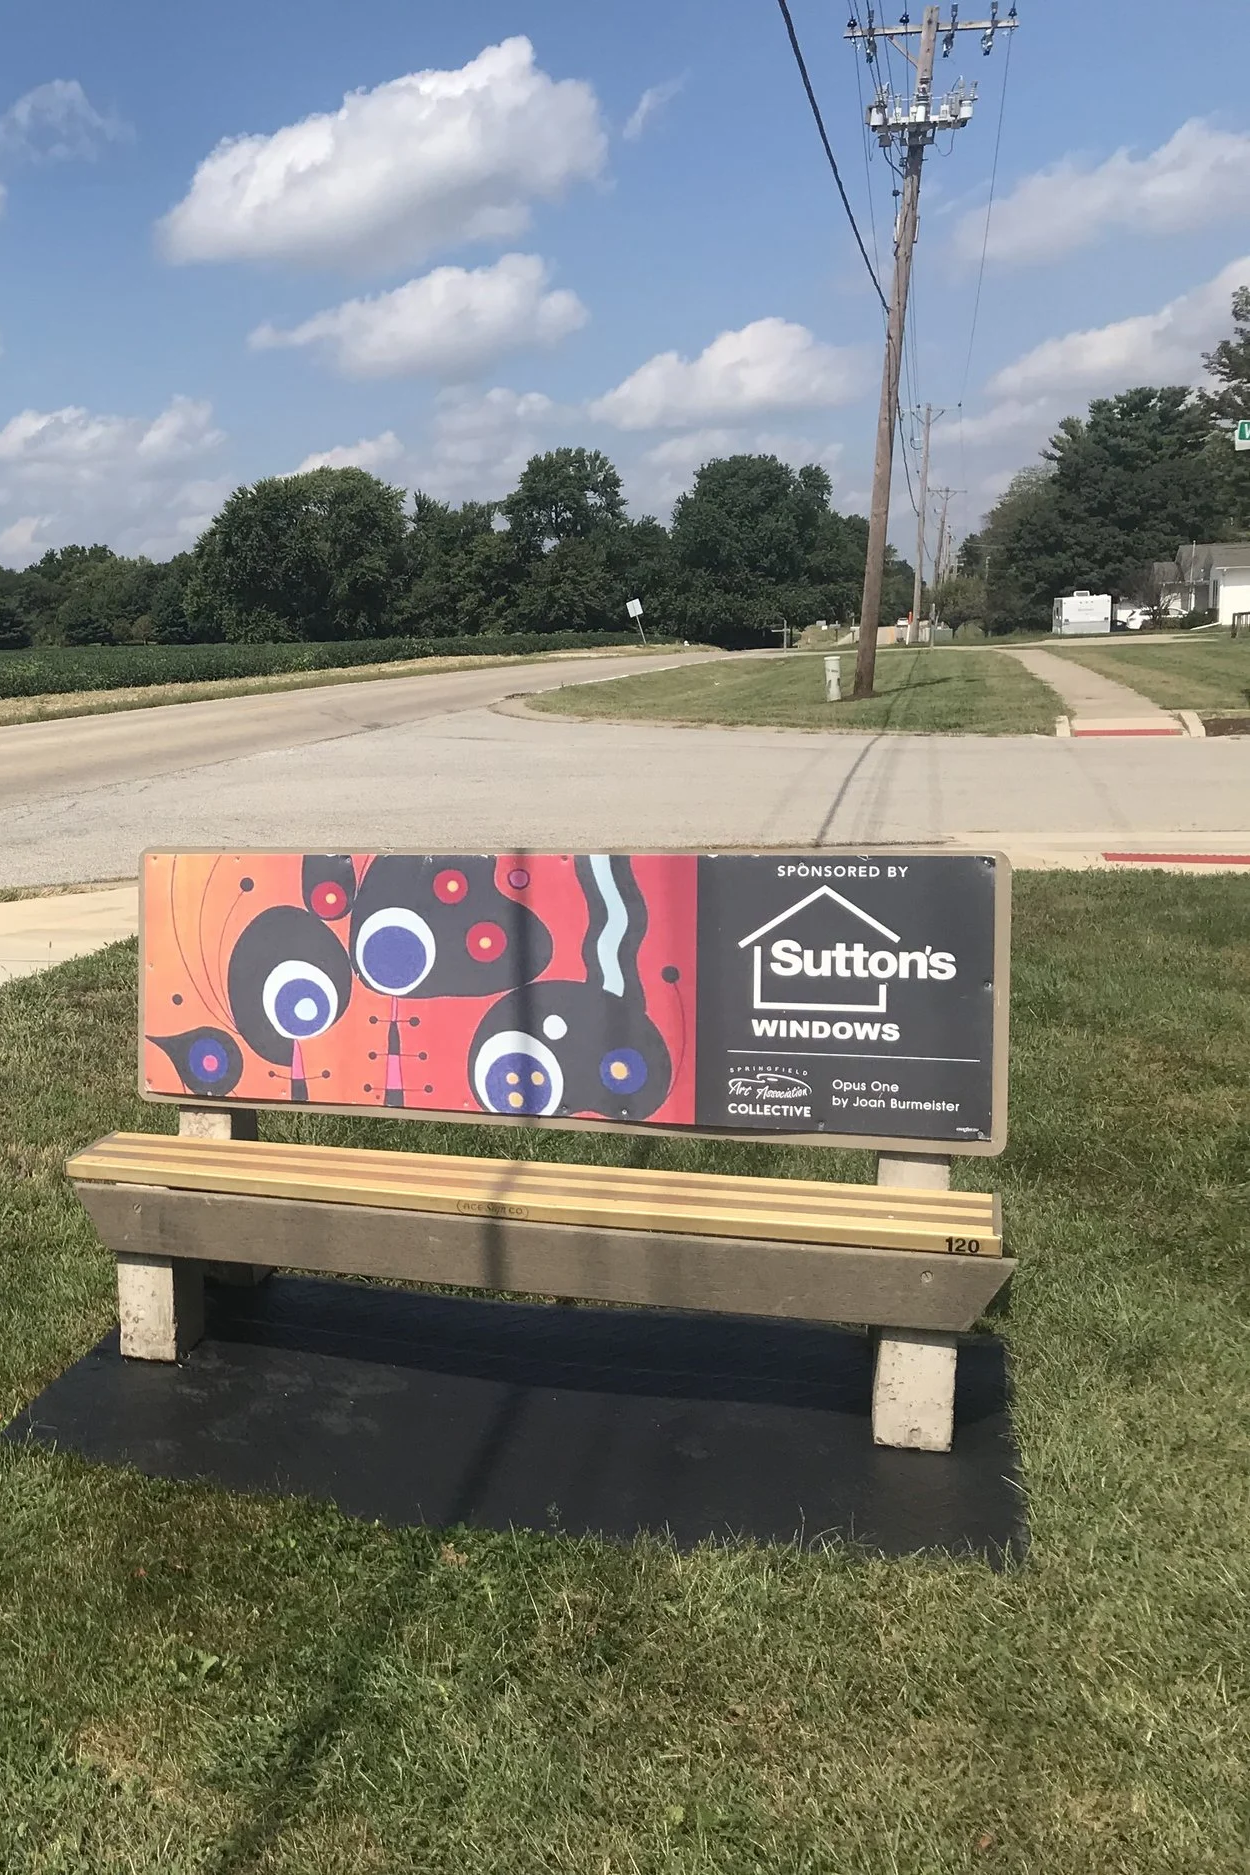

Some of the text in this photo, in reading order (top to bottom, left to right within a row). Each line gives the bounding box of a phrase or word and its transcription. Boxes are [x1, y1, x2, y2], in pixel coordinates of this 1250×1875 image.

[777, 865, 909, 878] SPONSORED BY
[770, 939, 957, 981] Sutton's
[751, 1018, 901, 1042] WINDOWS
[729, 1066, 808, 1076] SPRINGFIELD
[729, 1080, 808, 1099] Art Association
[832, 1079, 900, 1093] Opus One
[728, 1103, 812, 1118] COLLECTIVE
[832, 1095, 960, 1112] by Joan Burmeister
[463, 1202, 483, 1211] ACE
[508, 1207, 523, 1215] CO
[945, 1236, 980, 1253] 120
